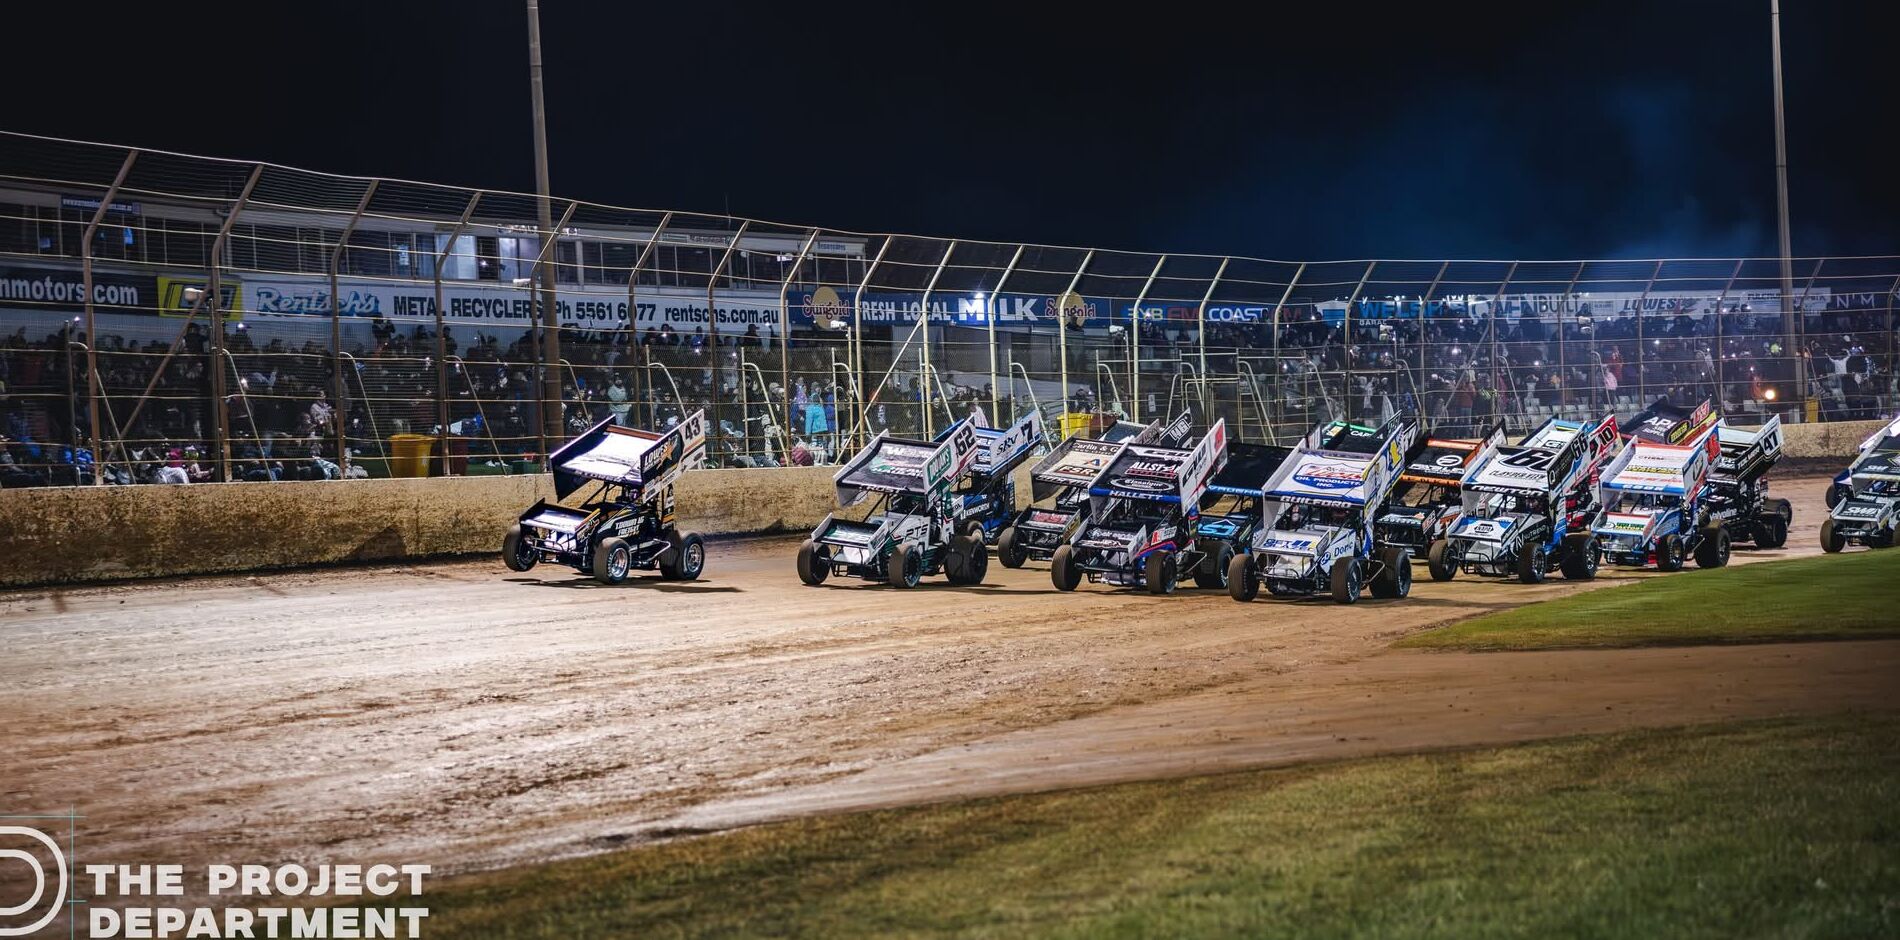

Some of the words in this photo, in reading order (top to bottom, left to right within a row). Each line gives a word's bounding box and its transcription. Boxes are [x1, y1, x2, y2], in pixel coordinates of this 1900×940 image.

[576, 302, 613, 320] 5561
[802, 294, 850, 322] Sungold
[685, 418, 701, 440] 43
[1021, 420, 1034, 444] 7
[1598, 425, 1614, 446] 10
[954, 424, 976, 456] 62
[1763, 431, 1778, 452] 47
[1109, 490, 1163, 499] HALLETT
